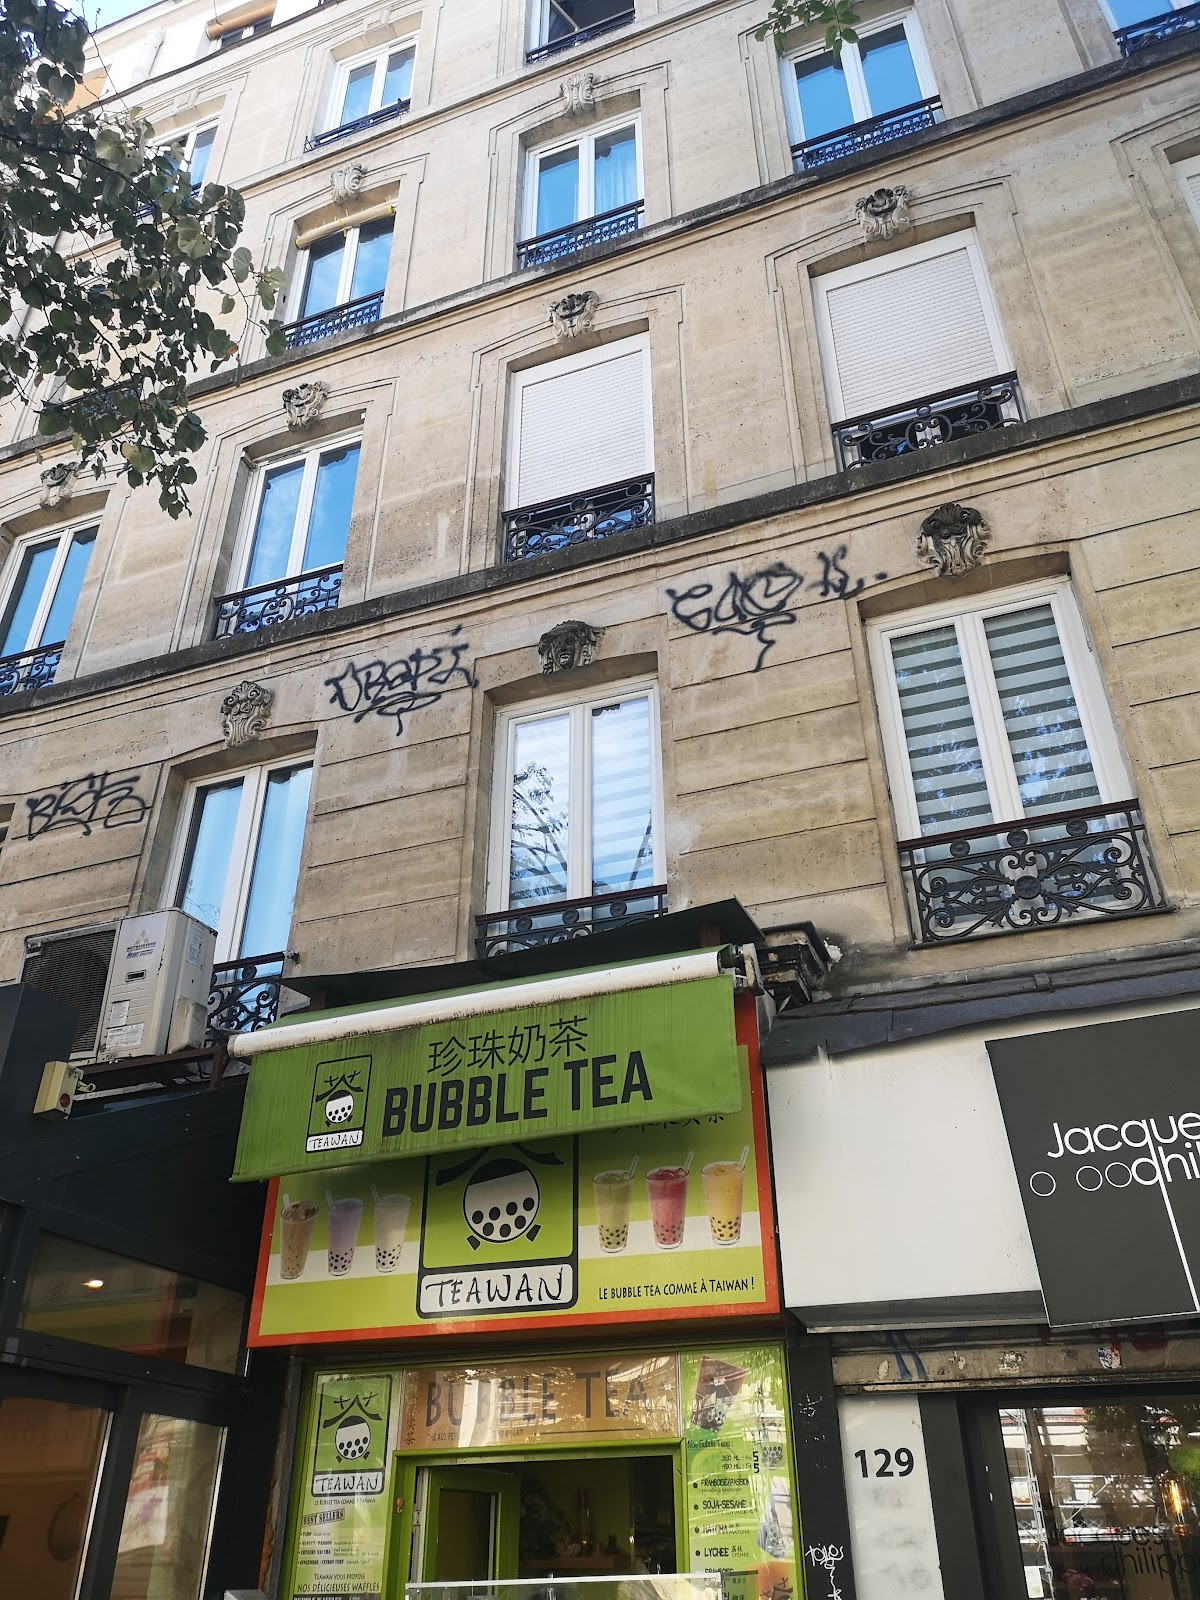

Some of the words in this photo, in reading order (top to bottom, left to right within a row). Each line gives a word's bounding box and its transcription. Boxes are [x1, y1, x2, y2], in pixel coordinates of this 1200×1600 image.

[427, 1015, 588, 1077] 珍珠奶茶
[382, 1067, 549, 1138] BUBBLE
[563, 1050, 653, 1112] TEA
[308, 1131, 360, 1149] TEAWAN
[424, 1267, 563, 1309] TEAWAN
[598, 1287, 608, 1300] LE
[611, 1286, 642, 1299] BUBBLE
[644, 1285, 661, 1297] TEA
[664, 1282, 698, 1295] COMME
[700, 1277, 708, 1293] À
[709, 1278, 748, 1292] TAIWAN
[854, 1447, 914, 1478] 129
[315, 1473, 380, 1492] TEAWAN
[303, 1514, 317, 1526] BEST
[319, 1509, 344, 1523] SELLERS
[704, 1547, 730, 1558] LYCHEE
[297, 1583, 311, 1593] NOS
[312, 1581, 350, 1592] DÉLICIEUSES
[352, 1582, 380, 1591] WAFFLES
